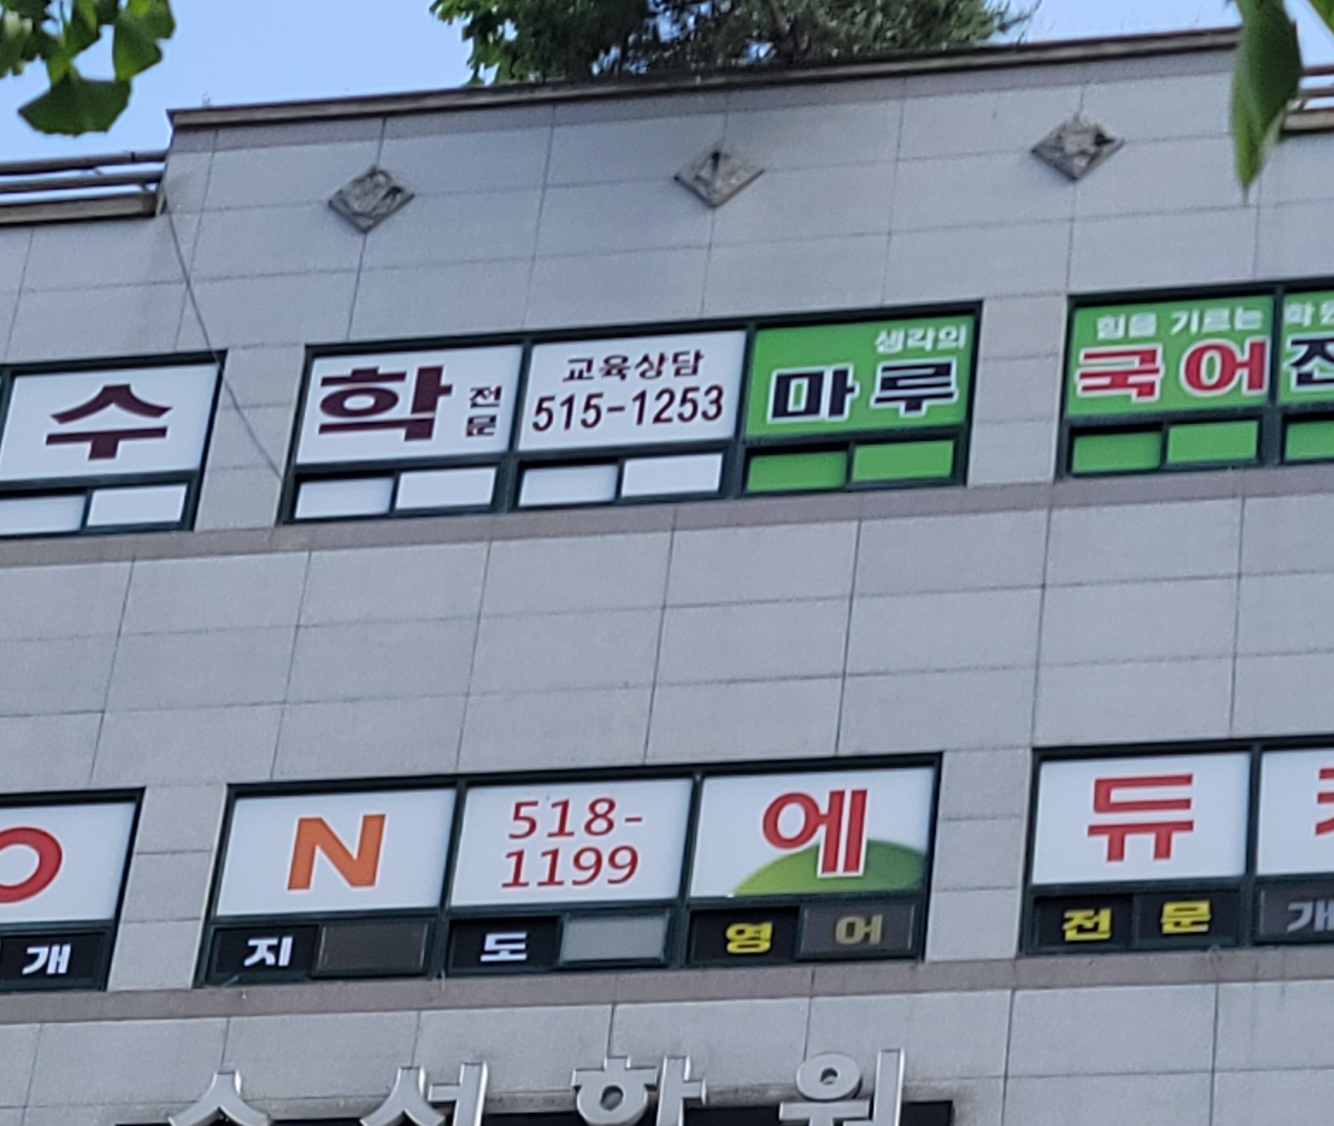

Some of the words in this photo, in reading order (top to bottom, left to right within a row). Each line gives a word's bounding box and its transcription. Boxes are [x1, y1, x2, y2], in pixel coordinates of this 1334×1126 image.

[874, 325, 967, 353] 생각의
[562, 349, 704, 383] 교육상담
[531, 384, 726, 434] 515-1253
[768, 358, 957, 423] 마루
